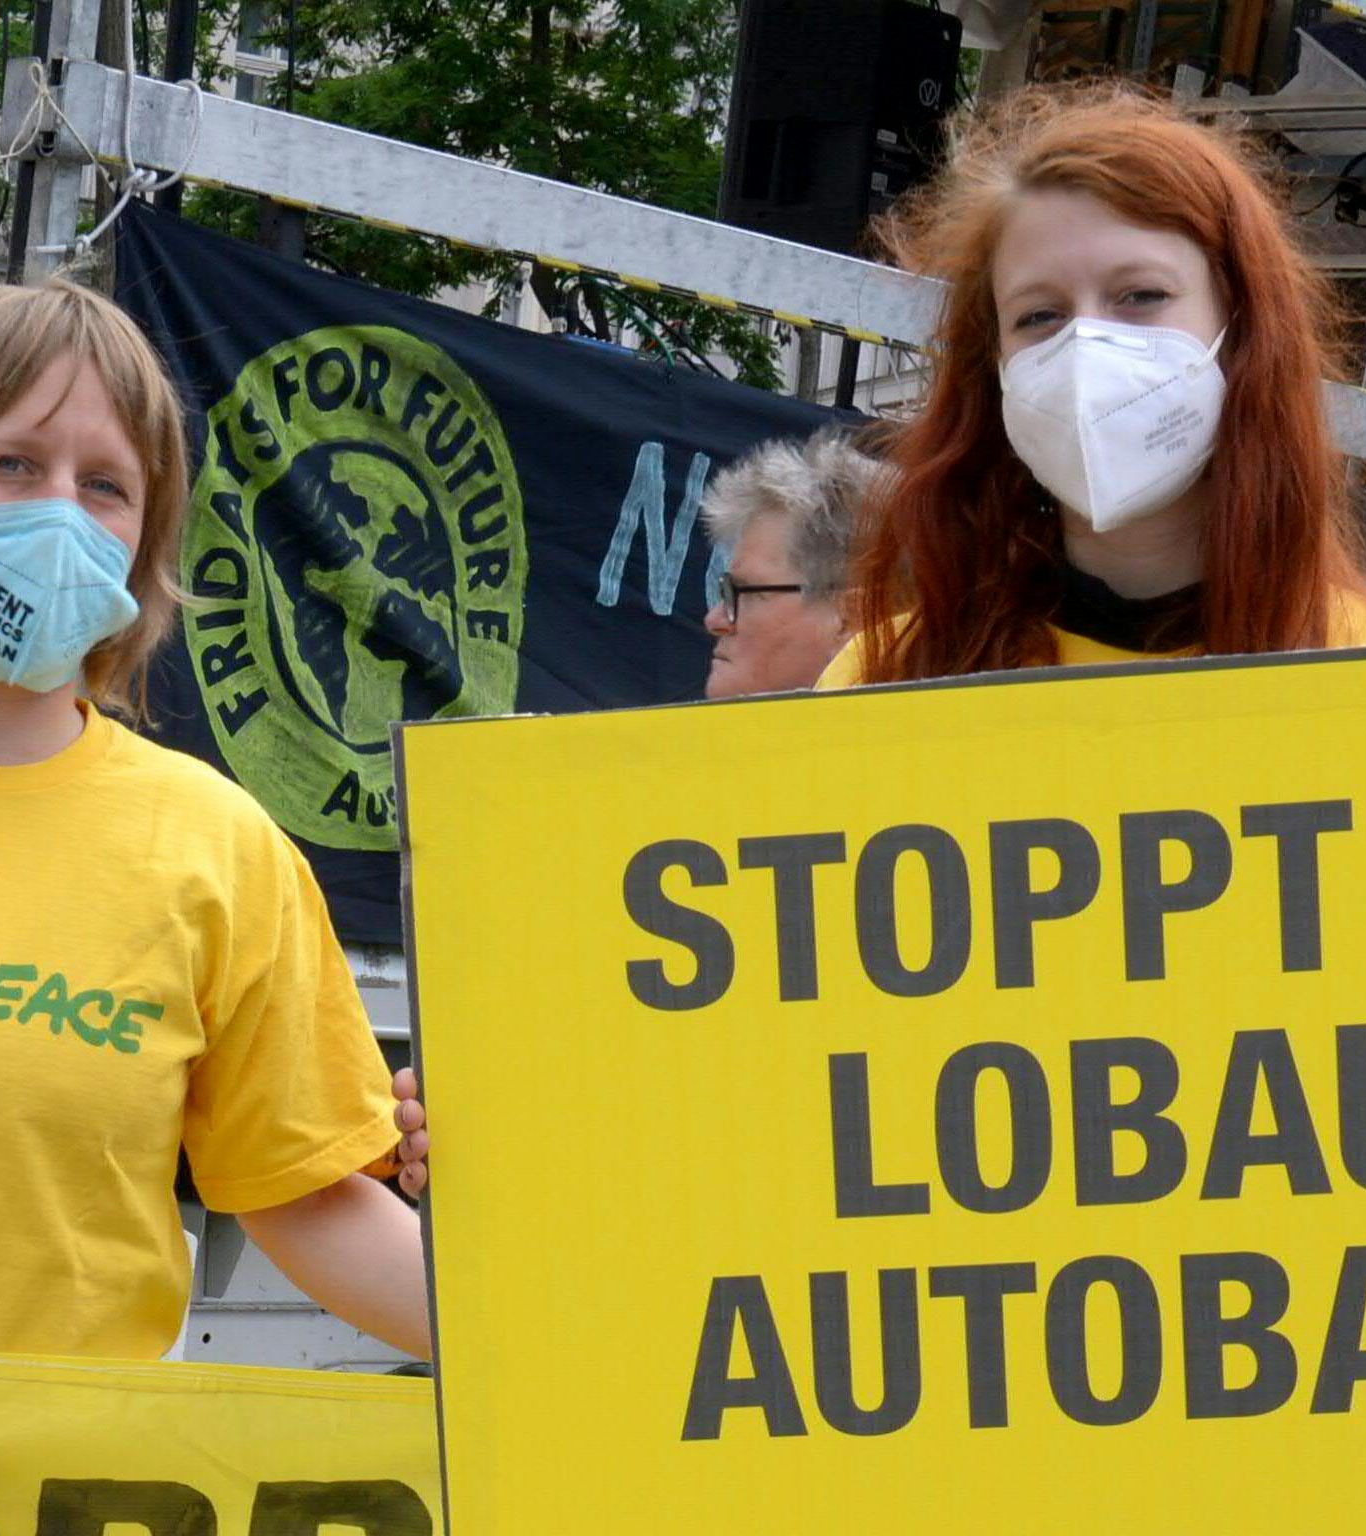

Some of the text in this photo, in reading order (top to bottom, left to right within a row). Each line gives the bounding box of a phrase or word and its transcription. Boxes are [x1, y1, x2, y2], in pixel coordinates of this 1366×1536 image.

[272, 343, 391, 424] FOR
[399, 371, 513, 645] FUTURE
[622, 799, 1354, 1012] STOPPT
